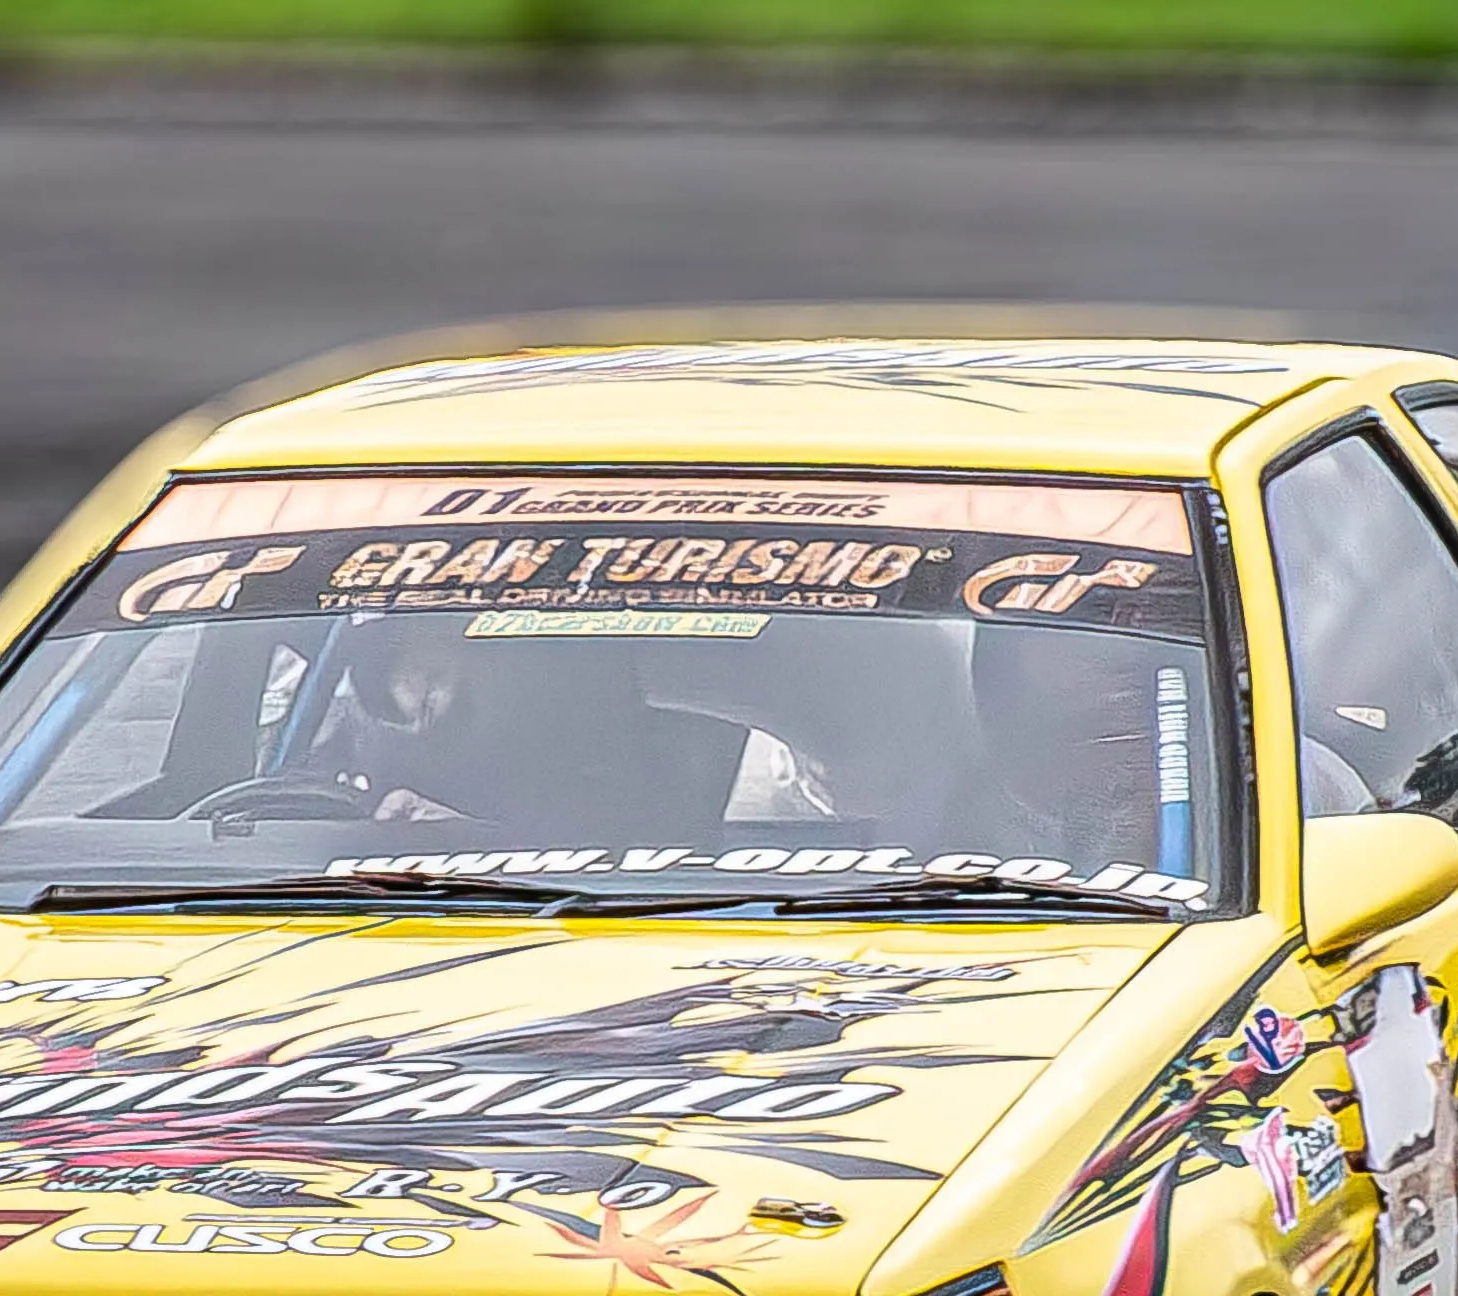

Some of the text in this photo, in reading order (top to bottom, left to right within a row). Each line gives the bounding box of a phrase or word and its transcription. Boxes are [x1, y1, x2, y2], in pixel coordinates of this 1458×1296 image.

[512, 498, 642, 517] GRAND
[648, 497, 739, 516] PRIX
[745, 499, 887, 520] SERIES
[329, 537, 922, 589] GRAN TURISMO
[52, 1222, 456, 1259] CUSCO
